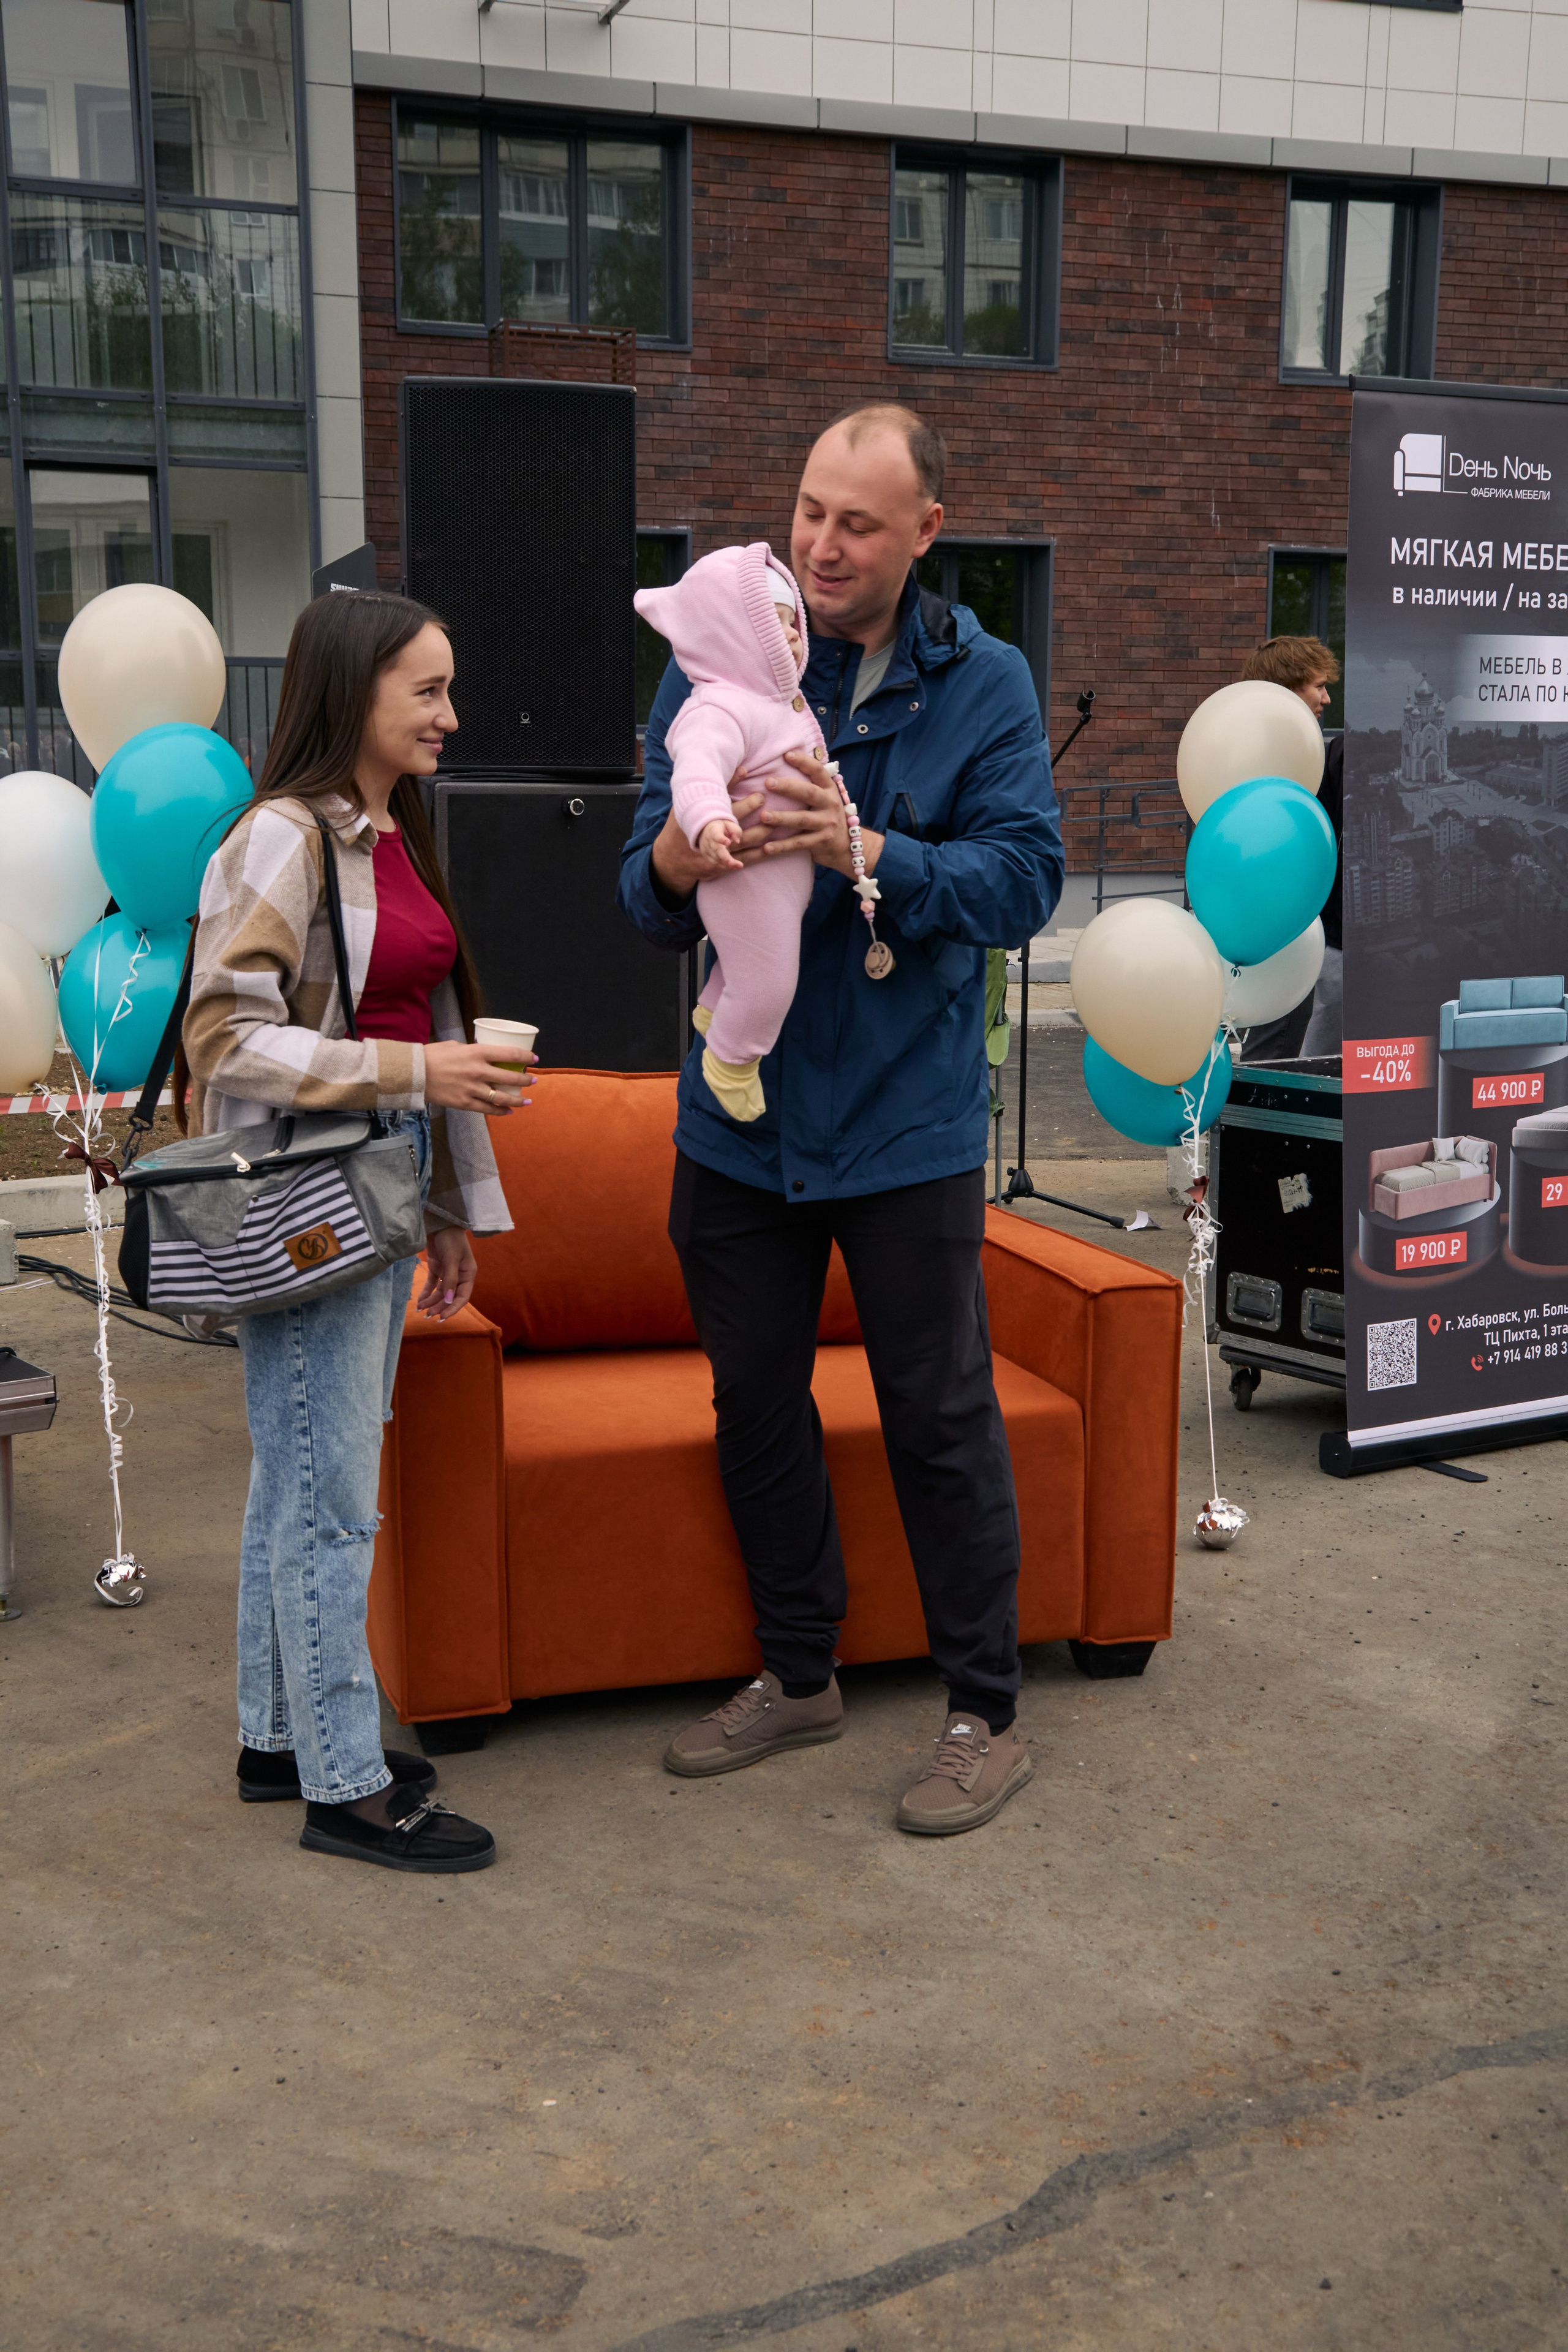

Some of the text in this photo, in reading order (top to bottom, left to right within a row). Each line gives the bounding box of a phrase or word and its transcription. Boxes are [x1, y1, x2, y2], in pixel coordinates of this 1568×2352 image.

[1471, 487, 1551, 500] ФАБРИКА МЕБЕЛИ
[1391, 537, 1568, 571] МЯГКАЯ МЕБЕ
[331, 583, 360, 592] SHUR
[1393, 582, 1568, 611] в наличии / на за
[1479, 657, 1562, 675] МЕБЕЛЬ В
[1479, 684, 1531, 702] СТАЛА
[1536, 685, 1557, 703] ПО
[1357, 1044, 1415, 1058] ВЫГОДА ДО
[1360, 1060, 1411, 1084] -40%
[1477, 1084, 1496, 1101] 44
[1501, 1080, 1526, 1100] 900
[1546, 1183, 1562, 1201] 29
[1401, 1244, 1415, 1262] 19
[1420, 1240, 1446, 1260] 900
[1446, 1321, 1454, 1331] г.
[1457, 1311, 1520, 1330] Хабаровск,
[1523, 1308, 1539, 1323] ул.
[1483, 1324, 1568, 1346] ТЦ Пихта, 1 эта
[1488, 1341, 1568, 1365] +7 914 419 88 3
